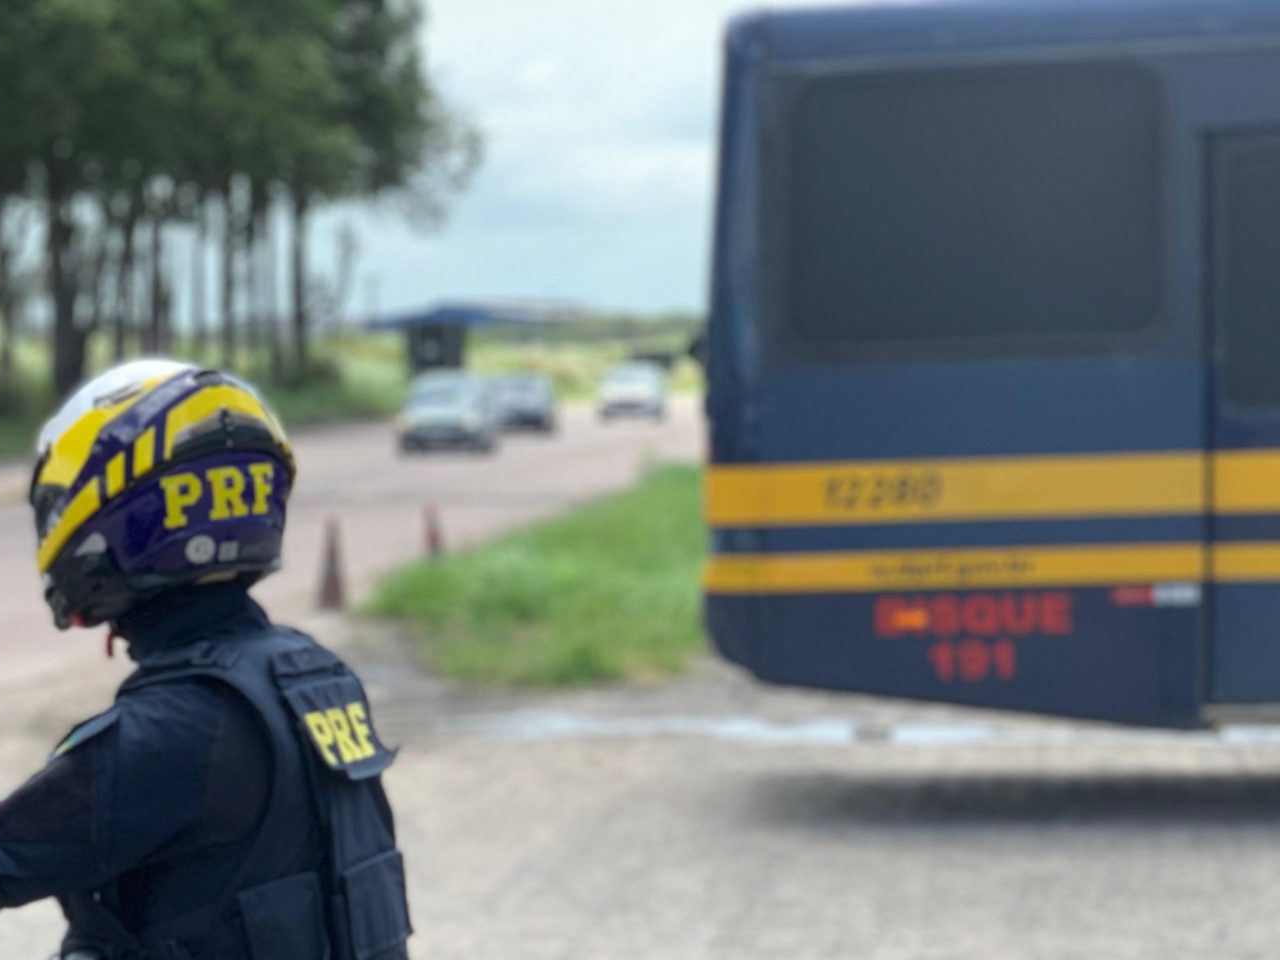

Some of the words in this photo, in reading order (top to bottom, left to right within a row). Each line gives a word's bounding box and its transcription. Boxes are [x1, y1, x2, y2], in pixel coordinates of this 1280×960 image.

[160, 462, 275, 529] PRF
[928, 640, 1017, 682] 191
[304, 702, 376, 767] PRF
